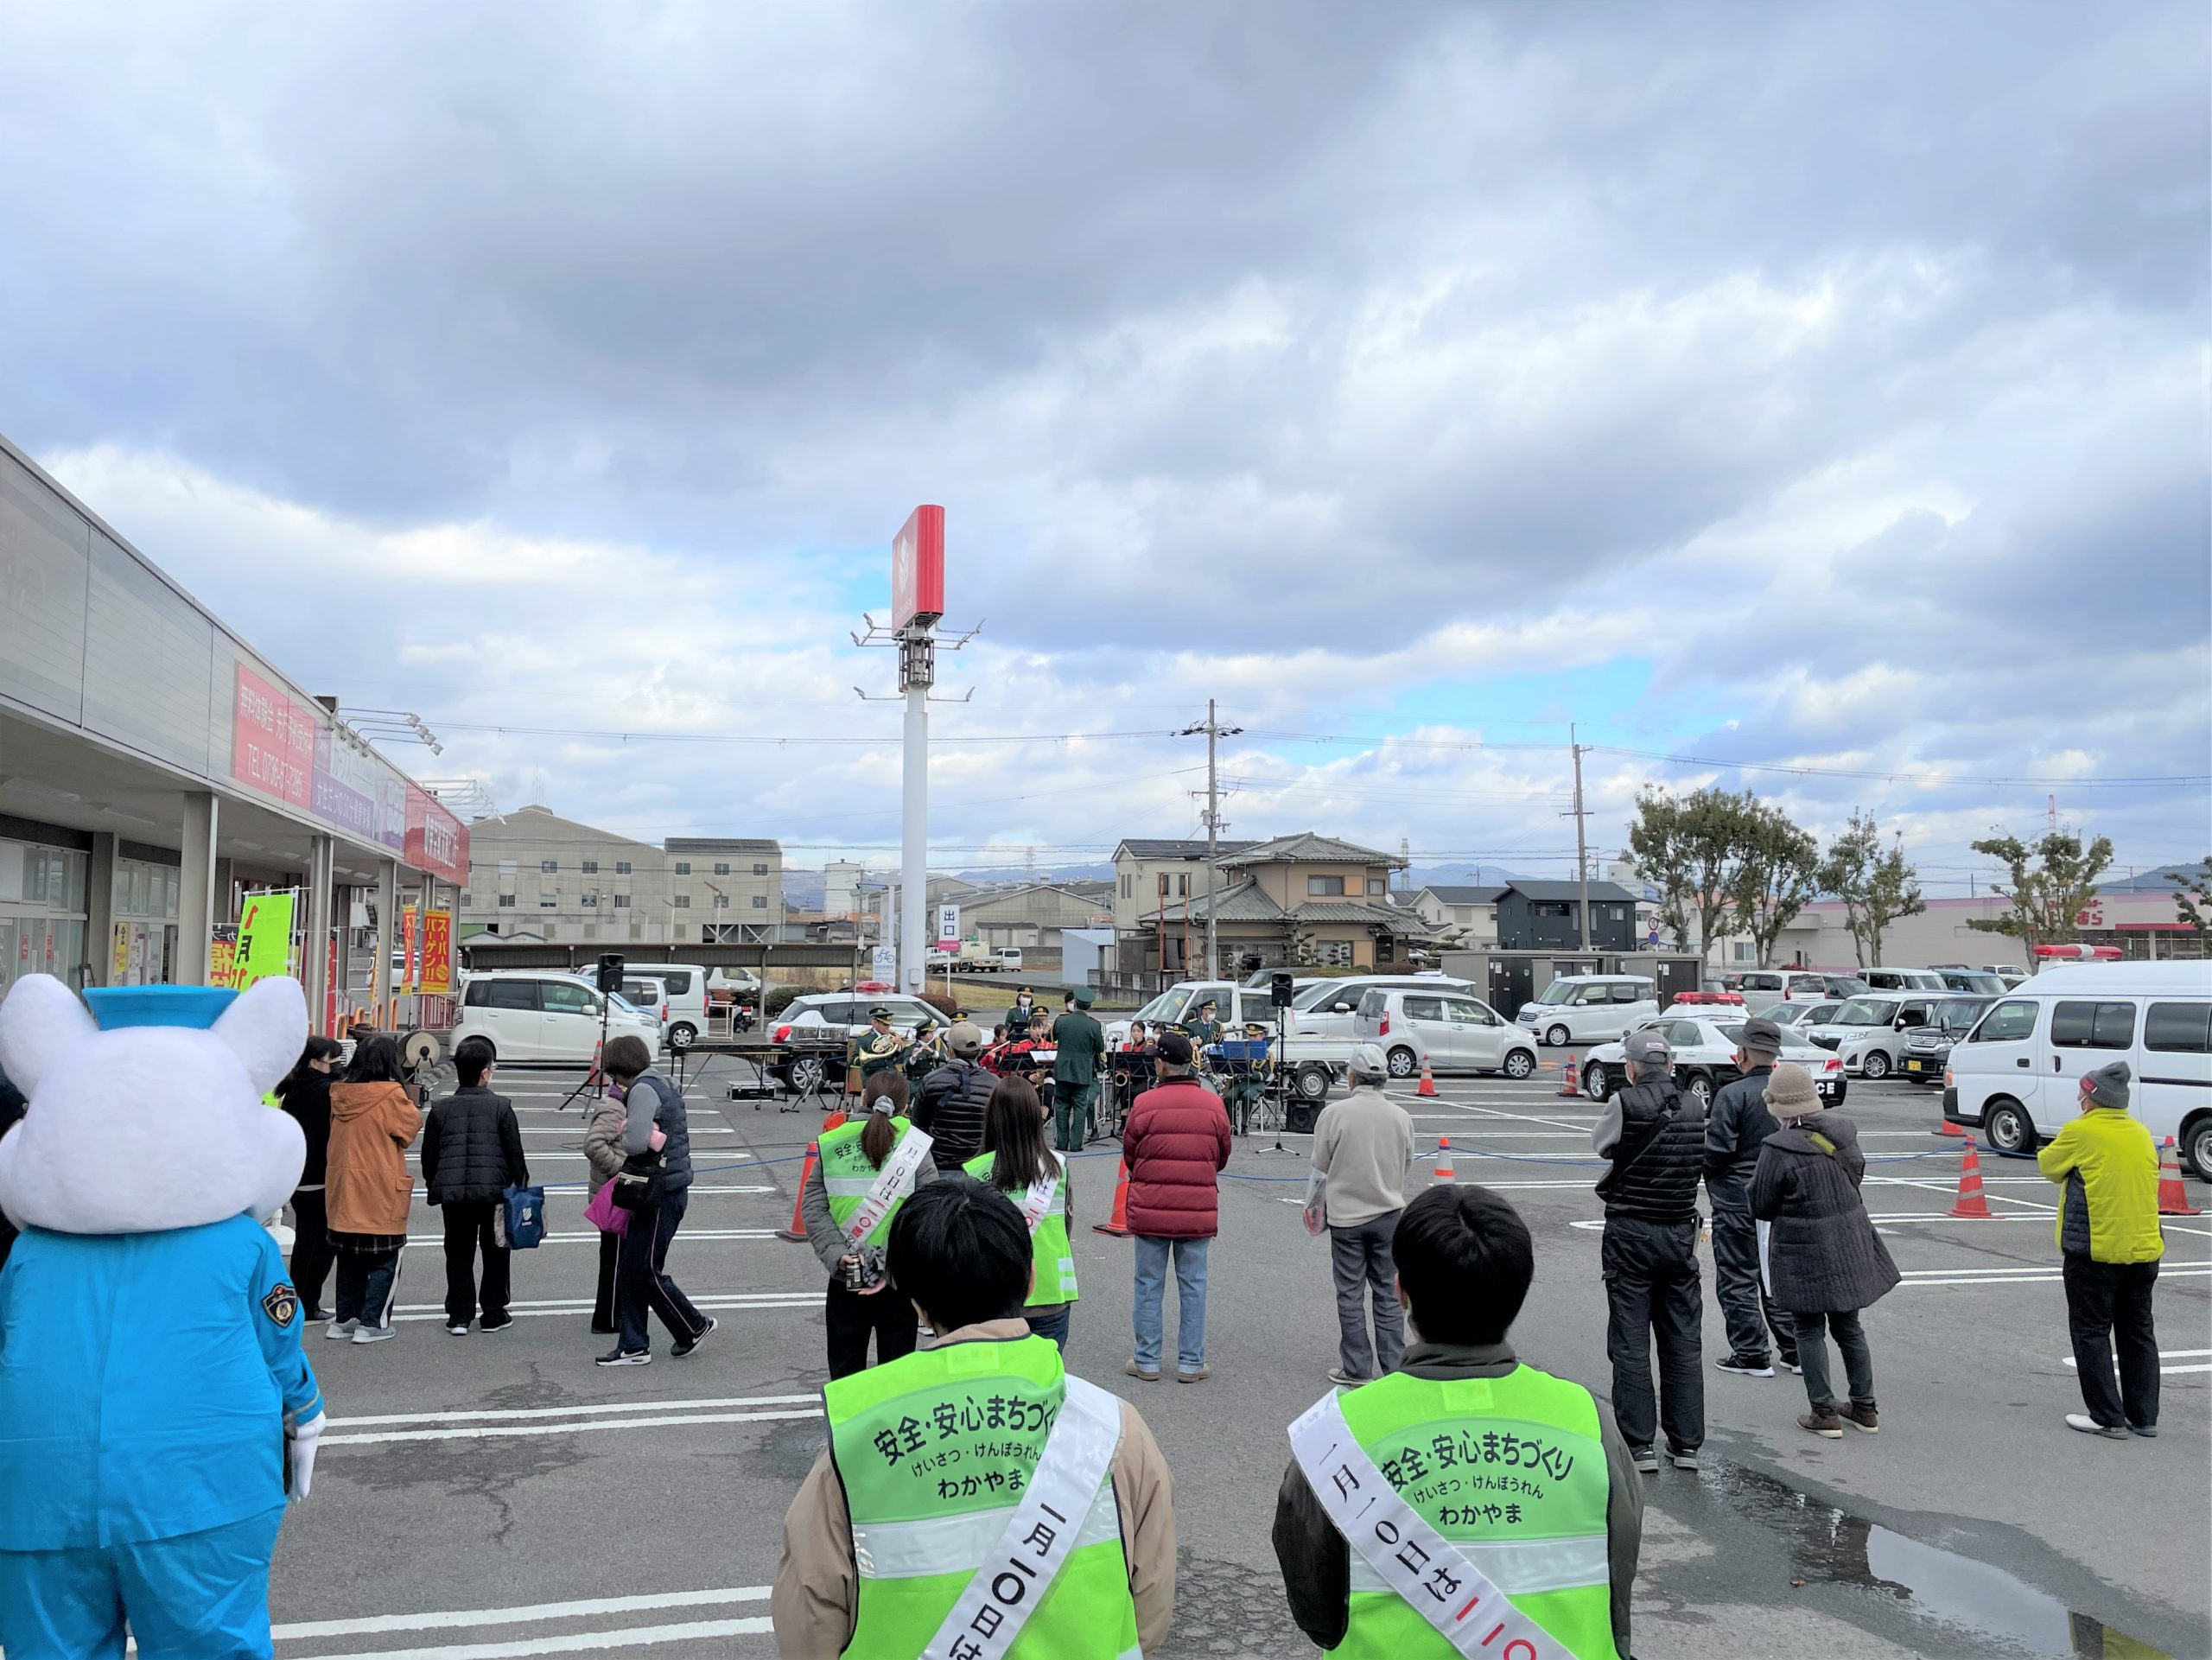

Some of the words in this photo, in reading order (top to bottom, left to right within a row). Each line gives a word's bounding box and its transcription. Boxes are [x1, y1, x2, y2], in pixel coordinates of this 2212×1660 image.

[247, 743, 261, 778] TEL
[944, 909, 955, 936] 出口
[437, 919, 448, 964] スーパー
[1380, 1429, 1574, 1494] 安全・安心まちづくり
[938, 1468, 1027, 1500] わかやま
[1440, 1504, 1522, 1526] わかやま
